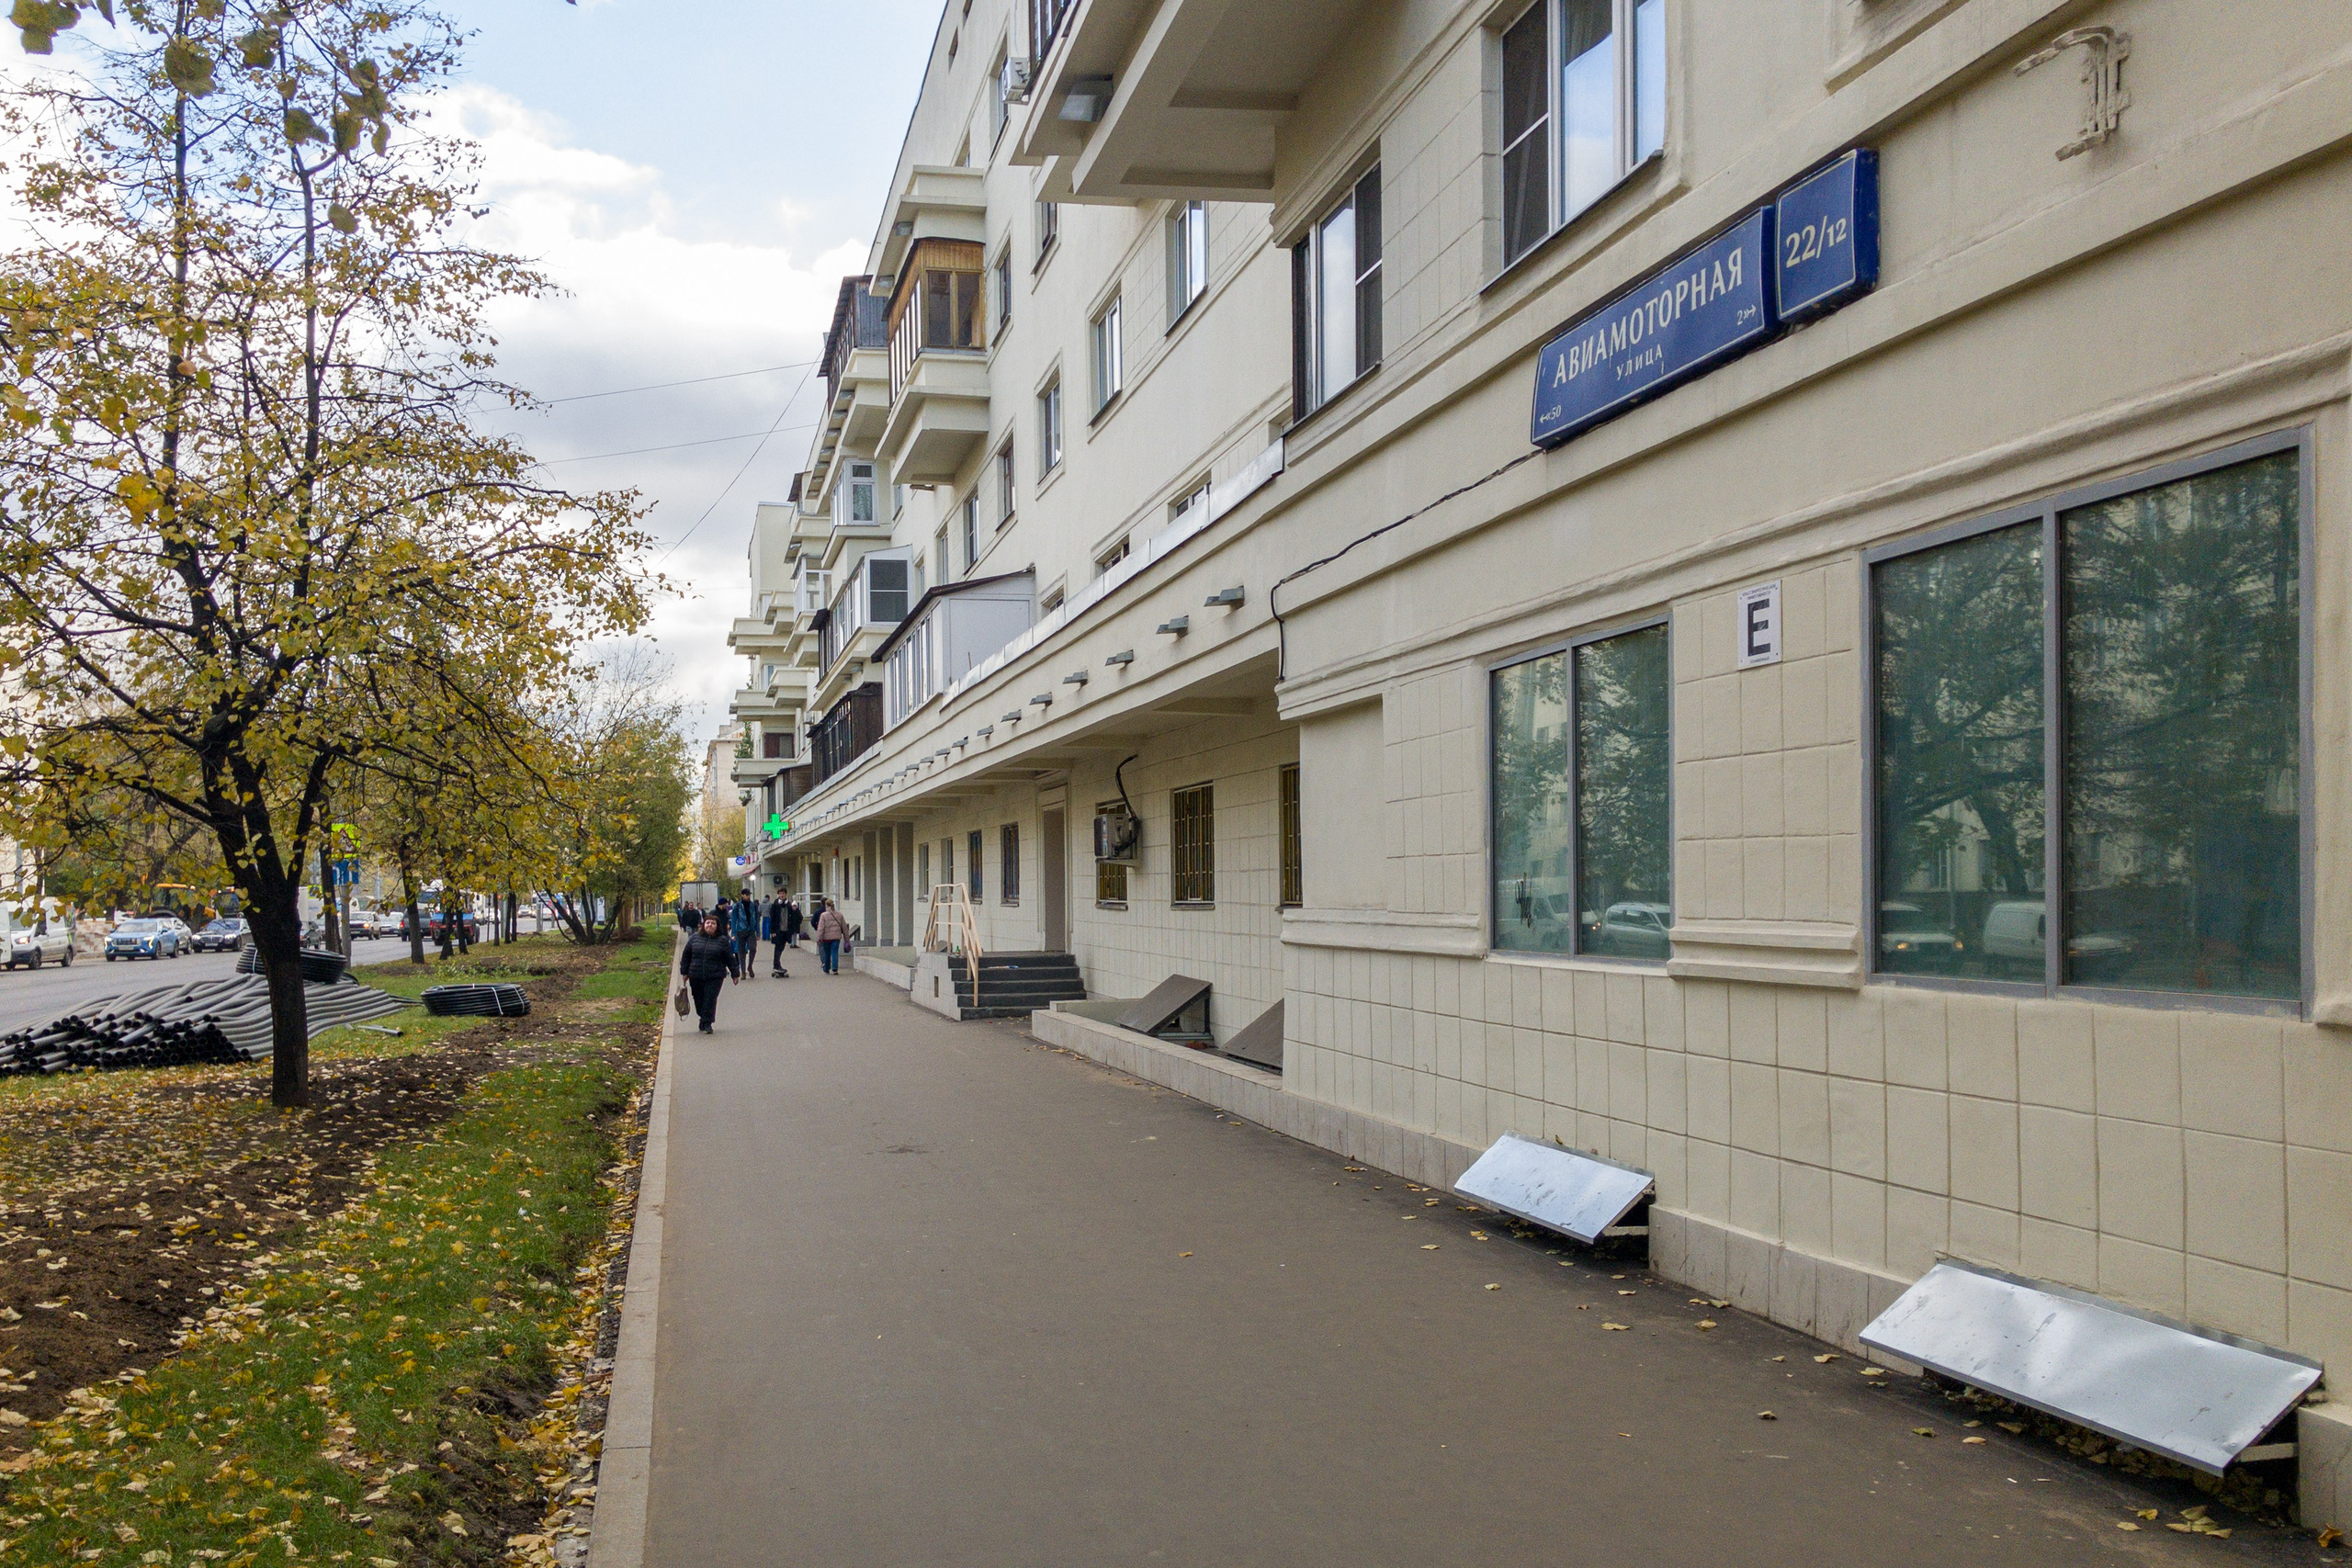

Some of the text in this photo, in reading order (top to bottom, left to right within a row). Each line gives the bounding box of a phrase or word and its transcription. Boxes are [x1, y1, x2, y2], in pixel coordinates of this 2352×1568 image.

[1785, 215, 1848, 268] 22/12
[1553, 247, 1742, 388] АВИАМОТОРНАЯ
[1616, 344, 1663, 381] УЛИЦА
